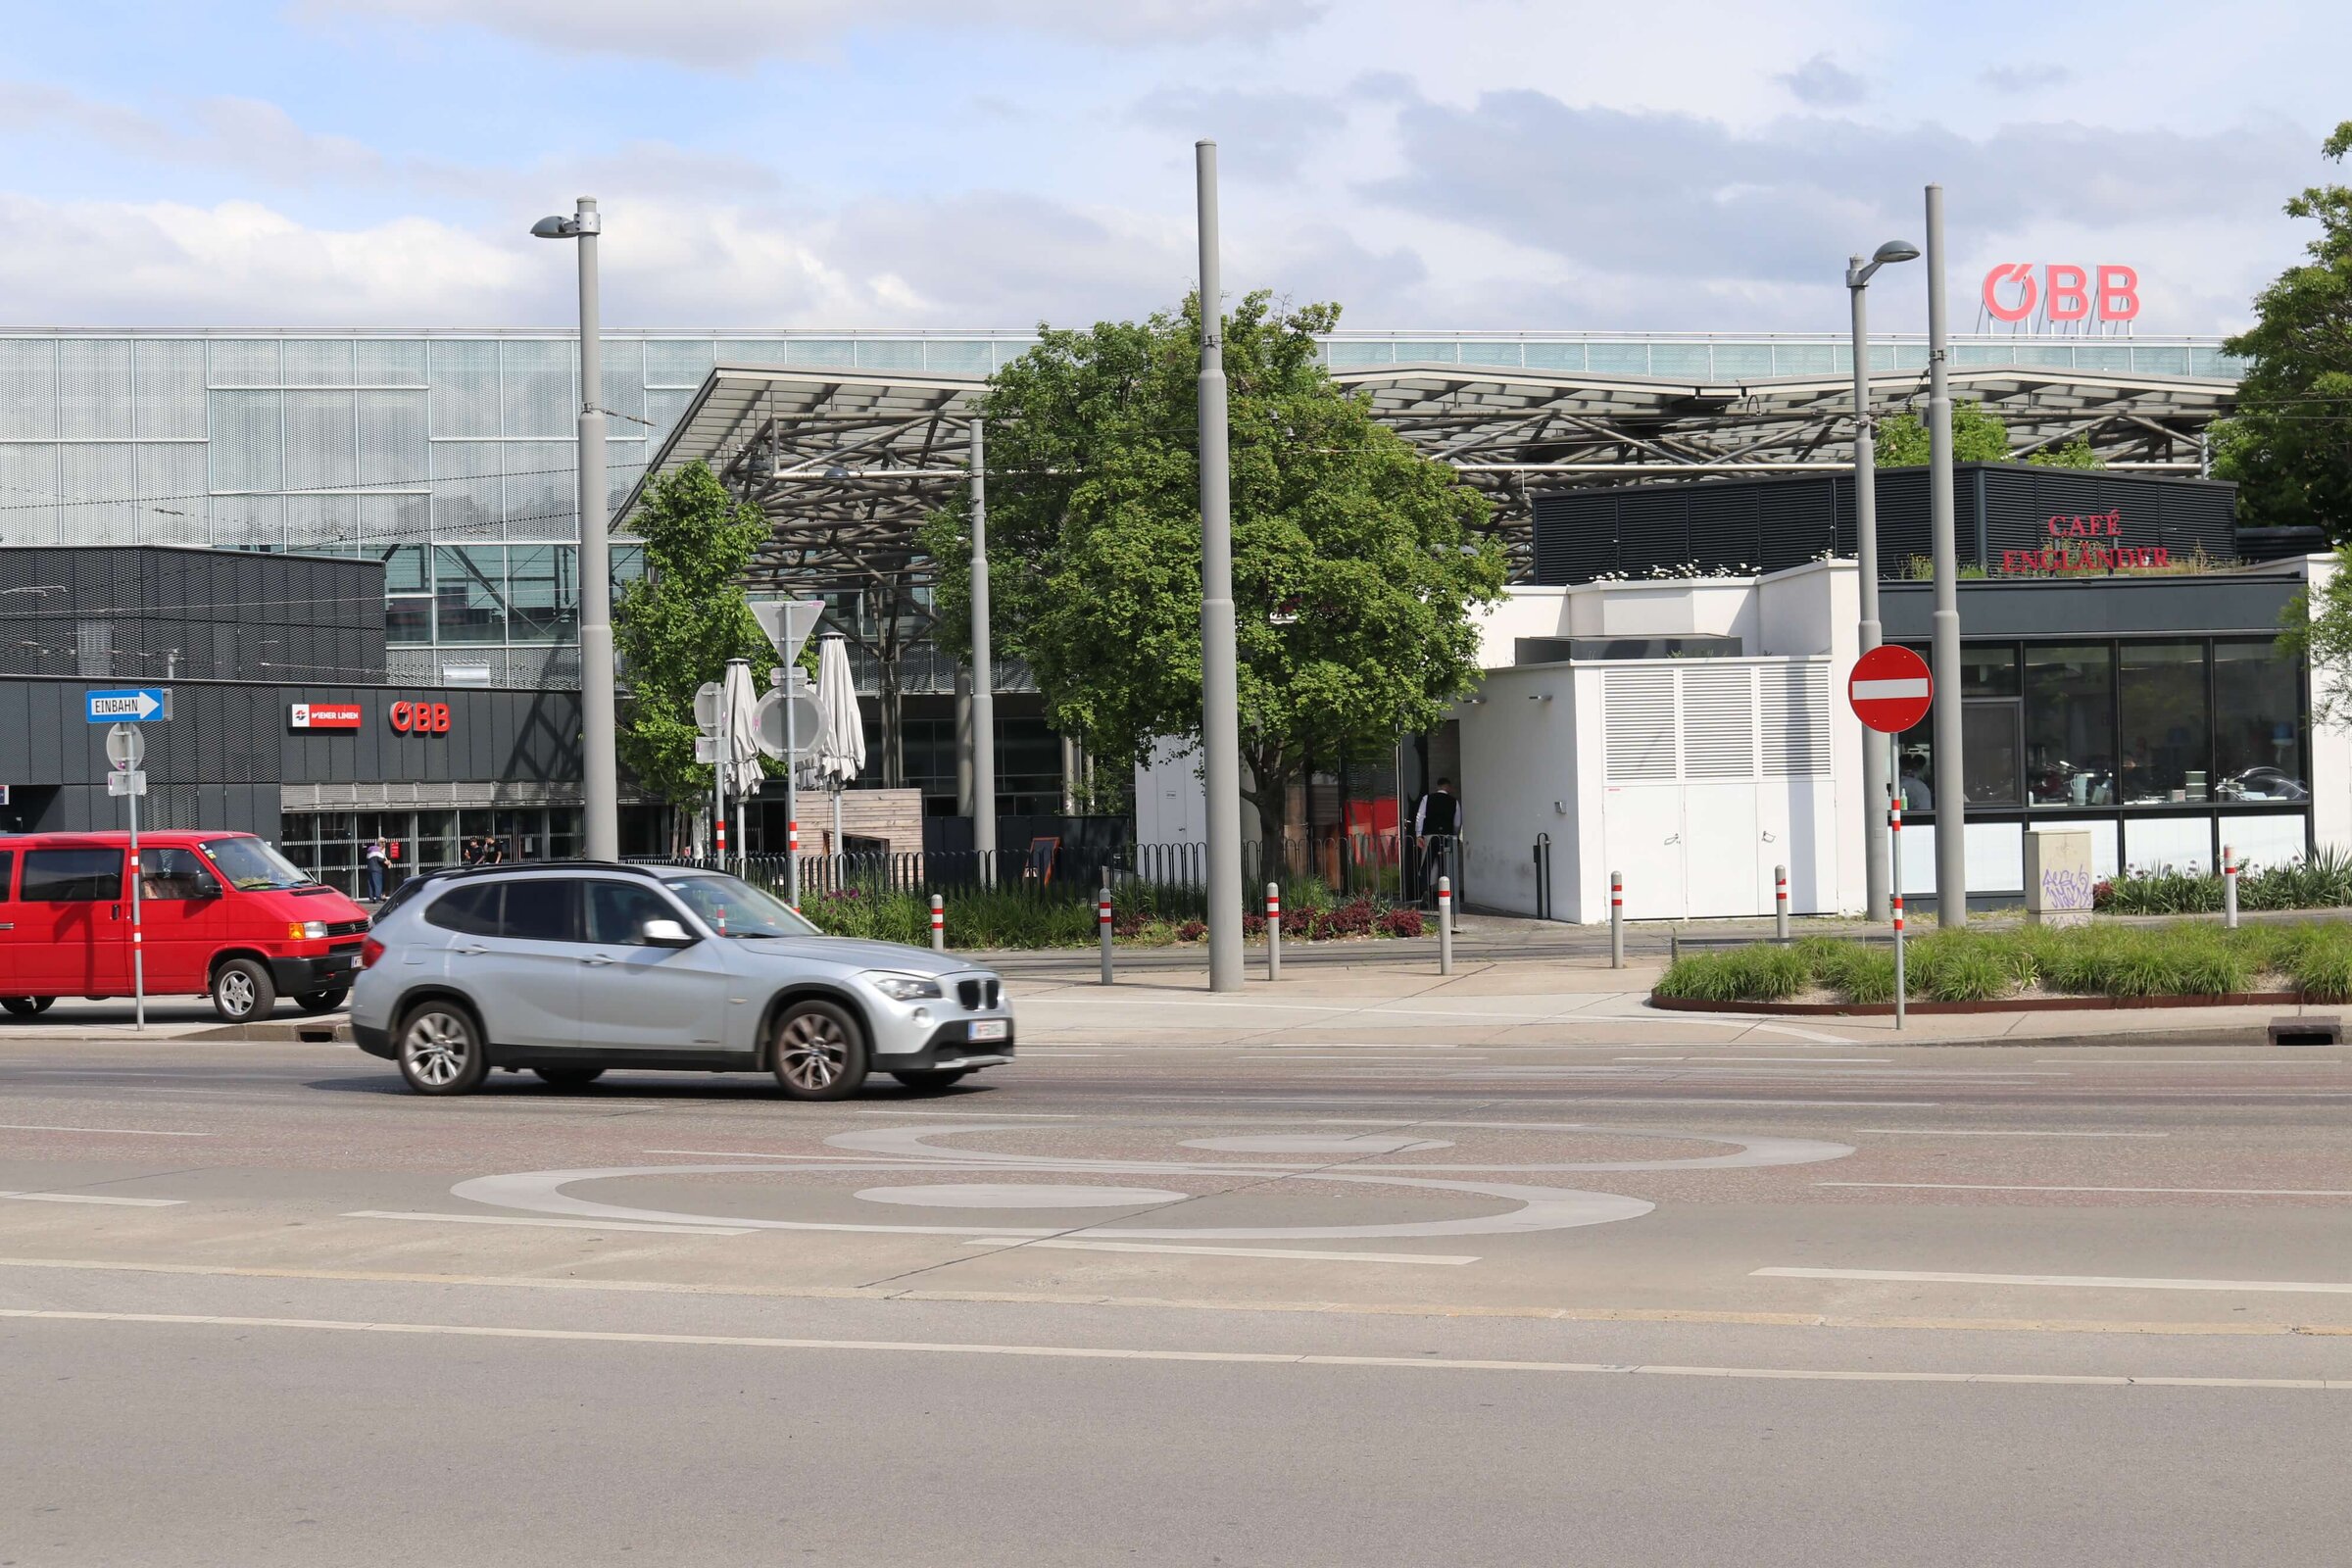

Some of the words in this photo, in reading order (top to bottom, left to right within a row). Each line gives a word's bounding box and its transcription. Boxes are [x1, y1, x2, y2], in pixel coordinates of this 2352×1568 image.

[1983, 263, 2140, 321] ÖBB
[2048, 509, 2123, 536] CAFÉ
[2002, 542, 2171, 572] ENGLÄNDER
[95, 700, 138, 713] EINBAHN
[390, 701, 450, 732] ÖBB
